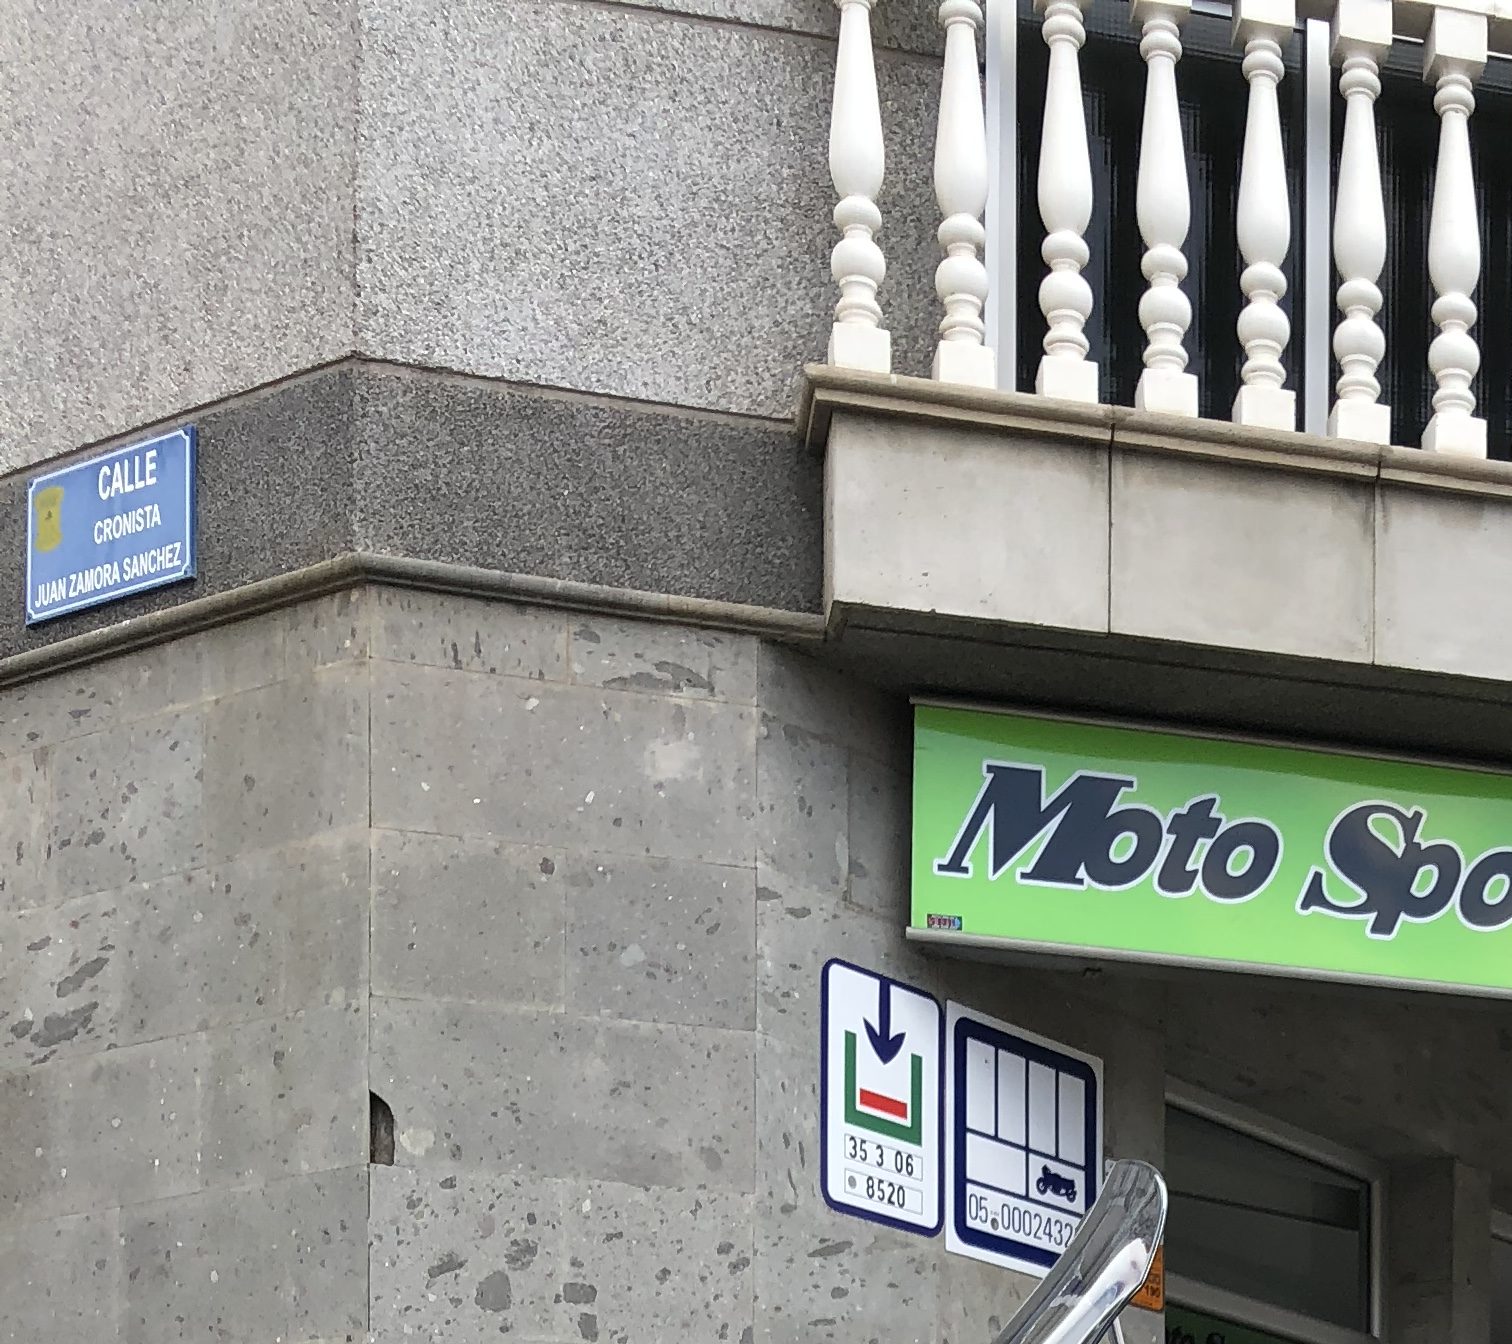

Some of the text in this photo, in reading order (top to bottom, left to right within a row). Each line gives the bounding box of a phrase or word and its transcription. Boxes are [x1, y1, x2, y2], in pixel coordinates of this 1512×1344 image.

[98, 449, 157, 500] CALLE
[94, 504, 161, 544] CRONISTA
[35, 541, 182, 608] JUAN ZAMORA SANCHEZ
[936, 763, 1281, 901] Moto
[849, 1136, 914, 1176] 35 3 06
[866, 1176, 905, 1208] 8520
[968, 1193, 988, 1224] 05
